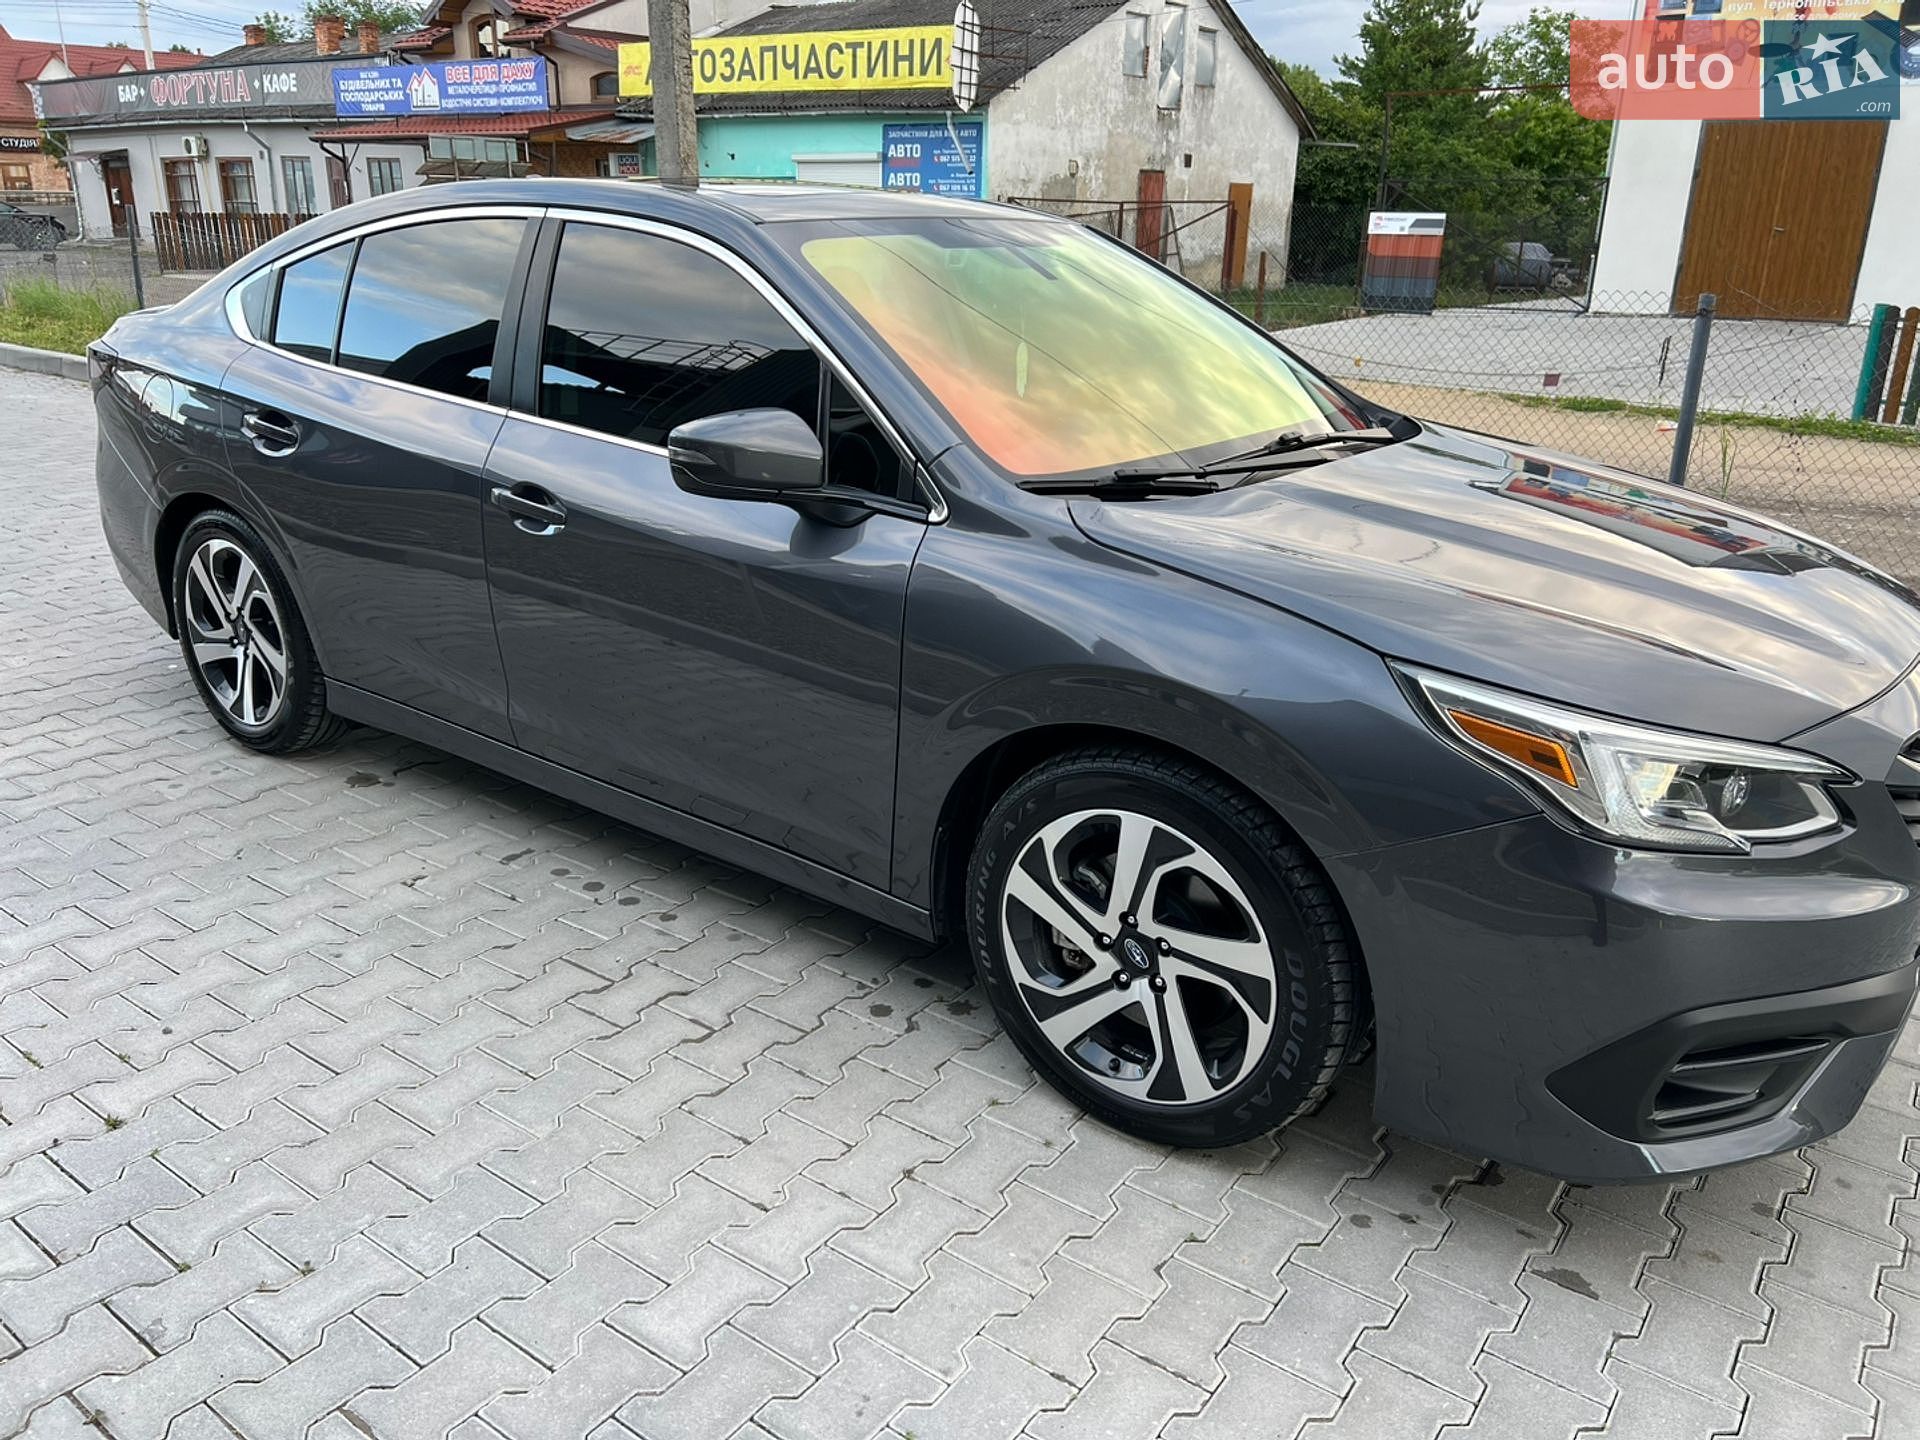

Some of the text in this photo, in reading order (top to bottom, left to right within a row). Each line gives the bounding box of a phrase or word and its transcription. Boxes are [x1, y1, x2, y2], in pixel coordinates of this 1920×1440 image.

[645, 37, 943, 85] ОЗАПЧАСТИНИ
[446, 62, 534, 84] ВСЕ ДЛЯ ДАХУ
[118, 69, 297, 107] БАР ФОРТУНА КАФЕ
[391, 78, 403, 89] ТА
[340, 90, 404, 102] ГОСПОДАРСЬКИХ
[1, 138, 37, 148] СТУДІЯ
[888, 144, 921, 157] АВТО
[888, 173, 921, 187] АВТО
[1233, 948, 1308, 1122] DOUGLAS
